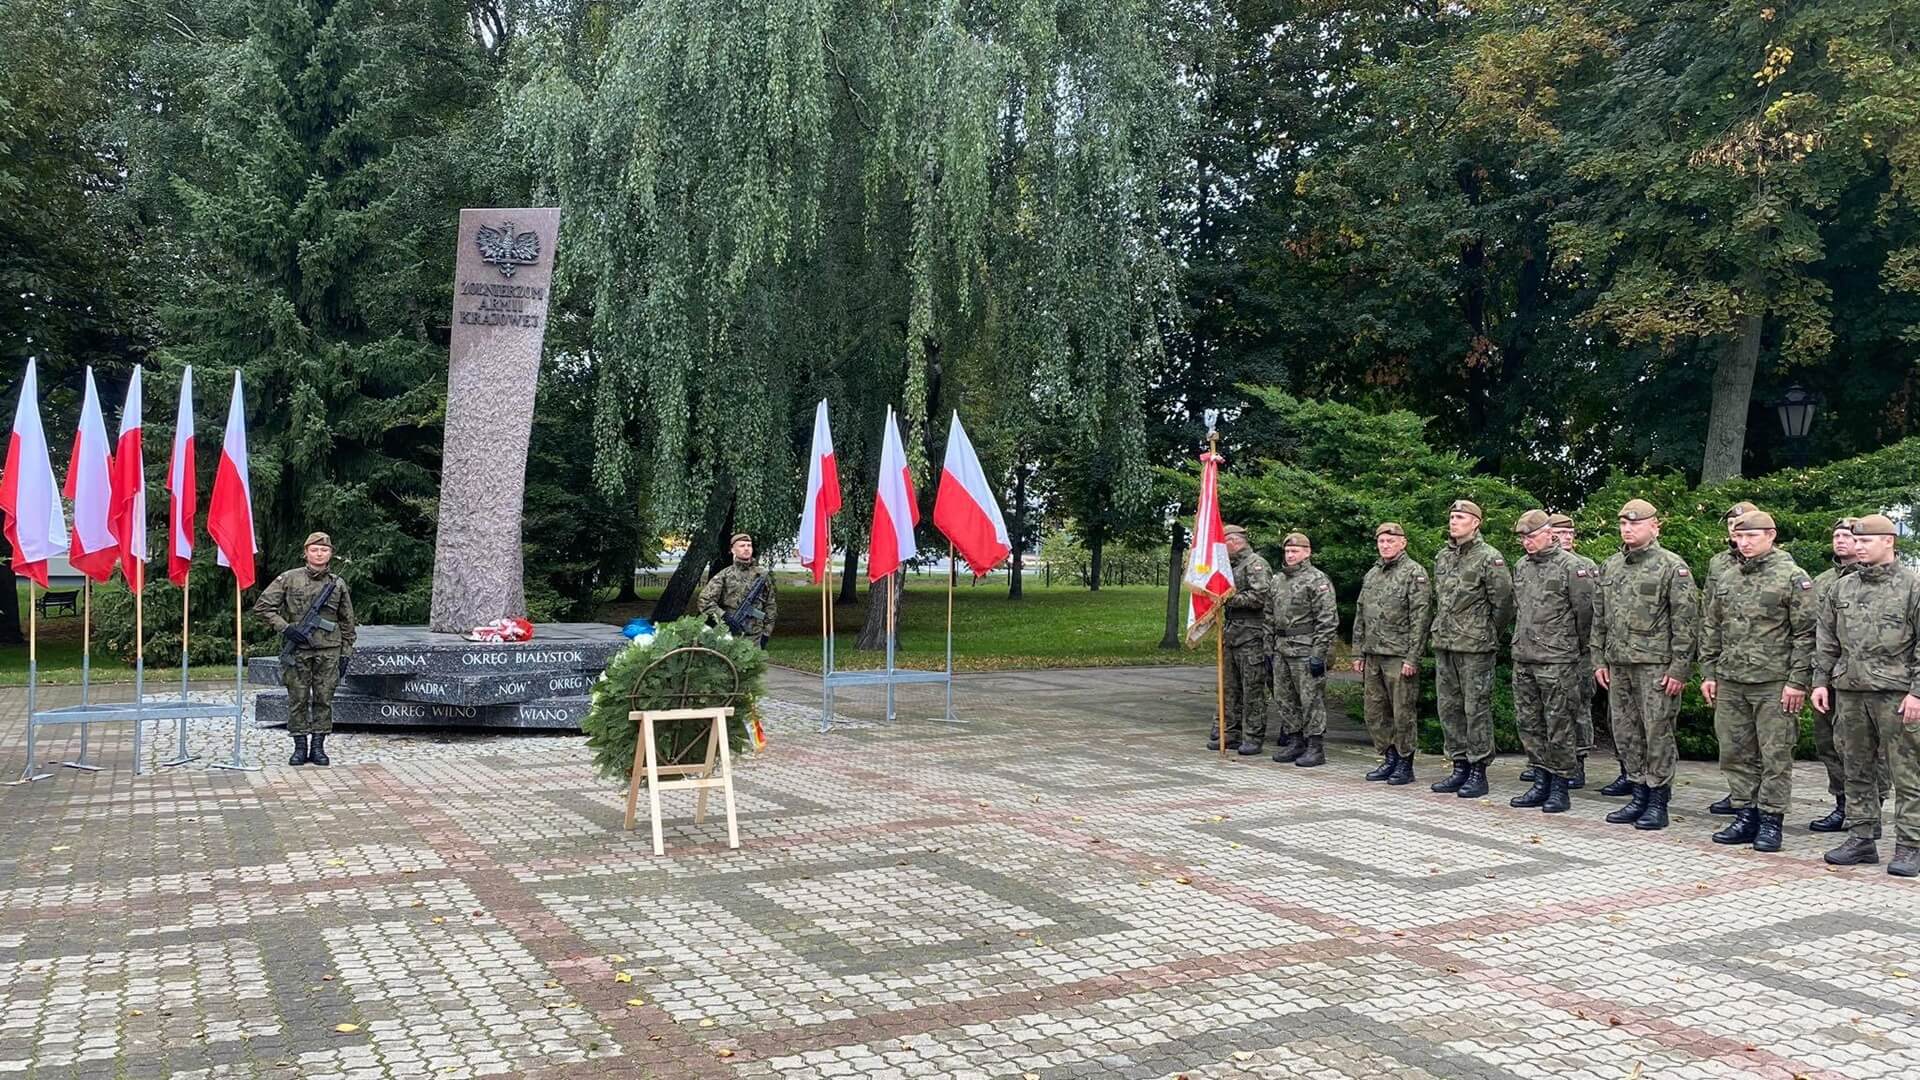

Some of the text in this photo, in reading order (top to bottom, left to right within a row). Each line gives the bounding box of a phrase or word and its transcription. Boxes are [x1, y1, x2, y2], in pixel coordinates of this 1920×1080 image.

[478, 299, 524, 312] ARMII
[459, 311, 540, 328] KRAJOWEJ
[462, 651, 583, 666] OKRĘG BIAŁYSTOK
[432, 705, 478, 719] WILNO
